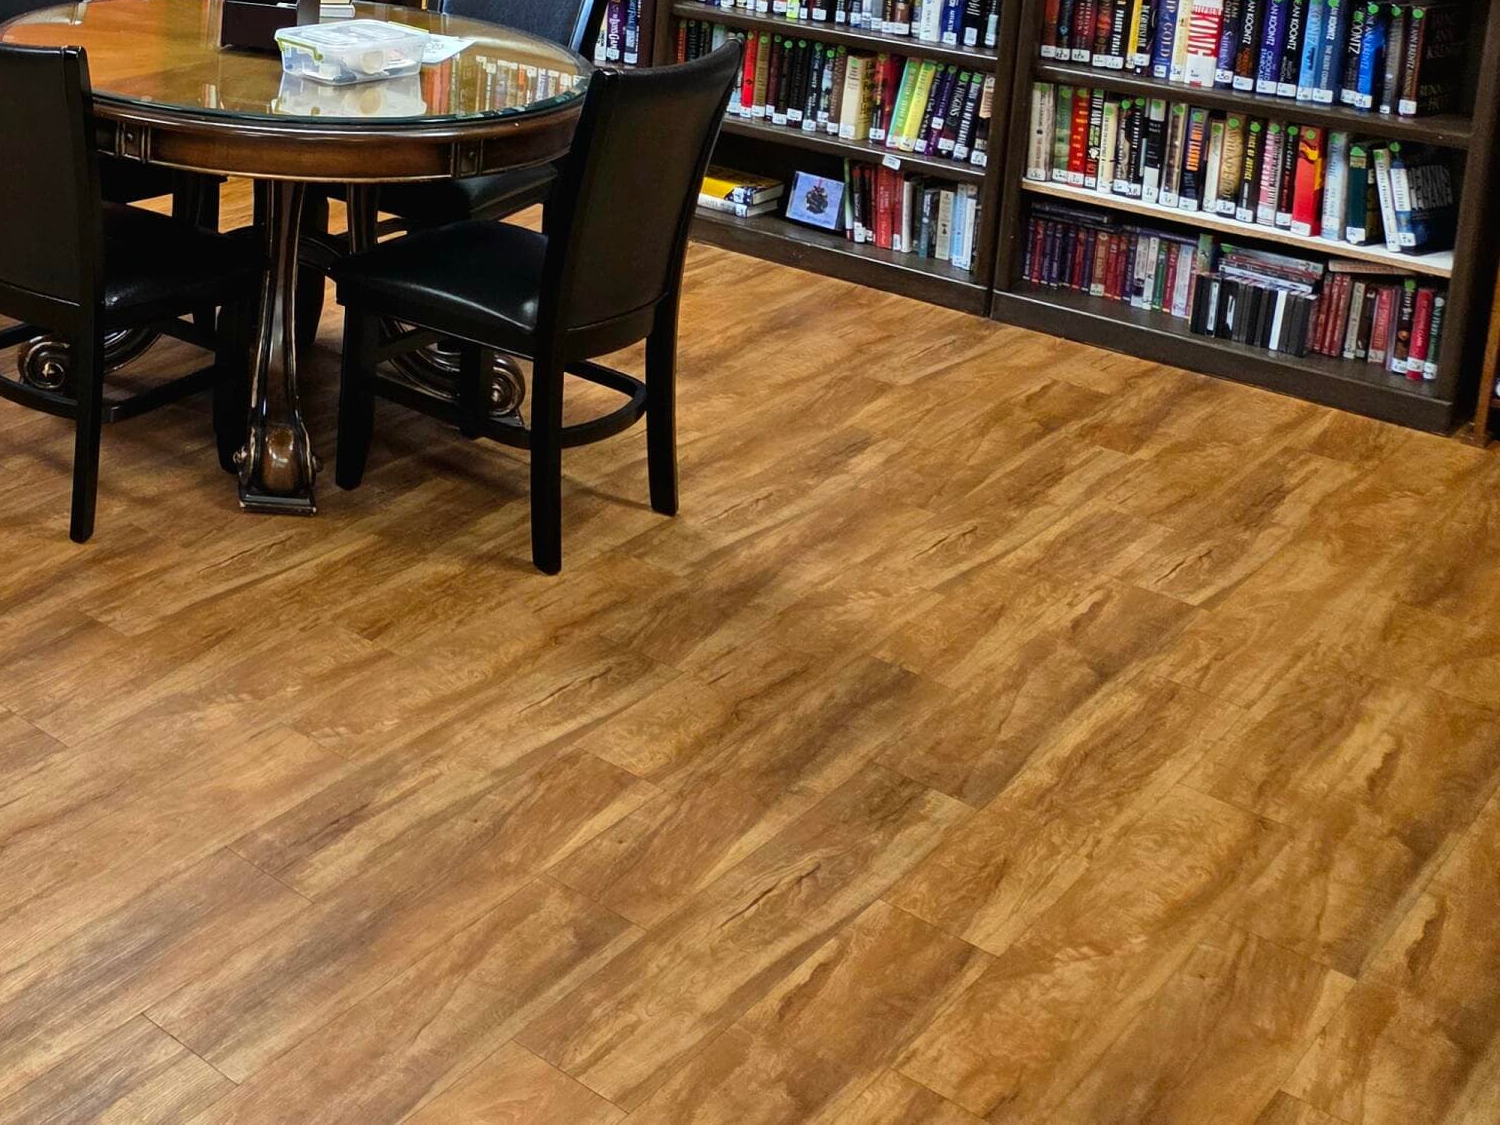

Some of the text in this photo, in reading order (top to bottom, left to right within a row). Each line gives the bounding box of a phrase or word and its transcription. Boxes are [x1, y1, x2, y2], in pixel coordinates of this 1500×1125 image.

[1159, 22, 1173, 57] GOLD
[1242, 12, 1255, 45] KOONTZ
[1265, 15, 1277, 46] KOONTZ
[1287, 18, 1300, 50] KOONTZ
[1348, 21, 1362, 54] OONTZ
